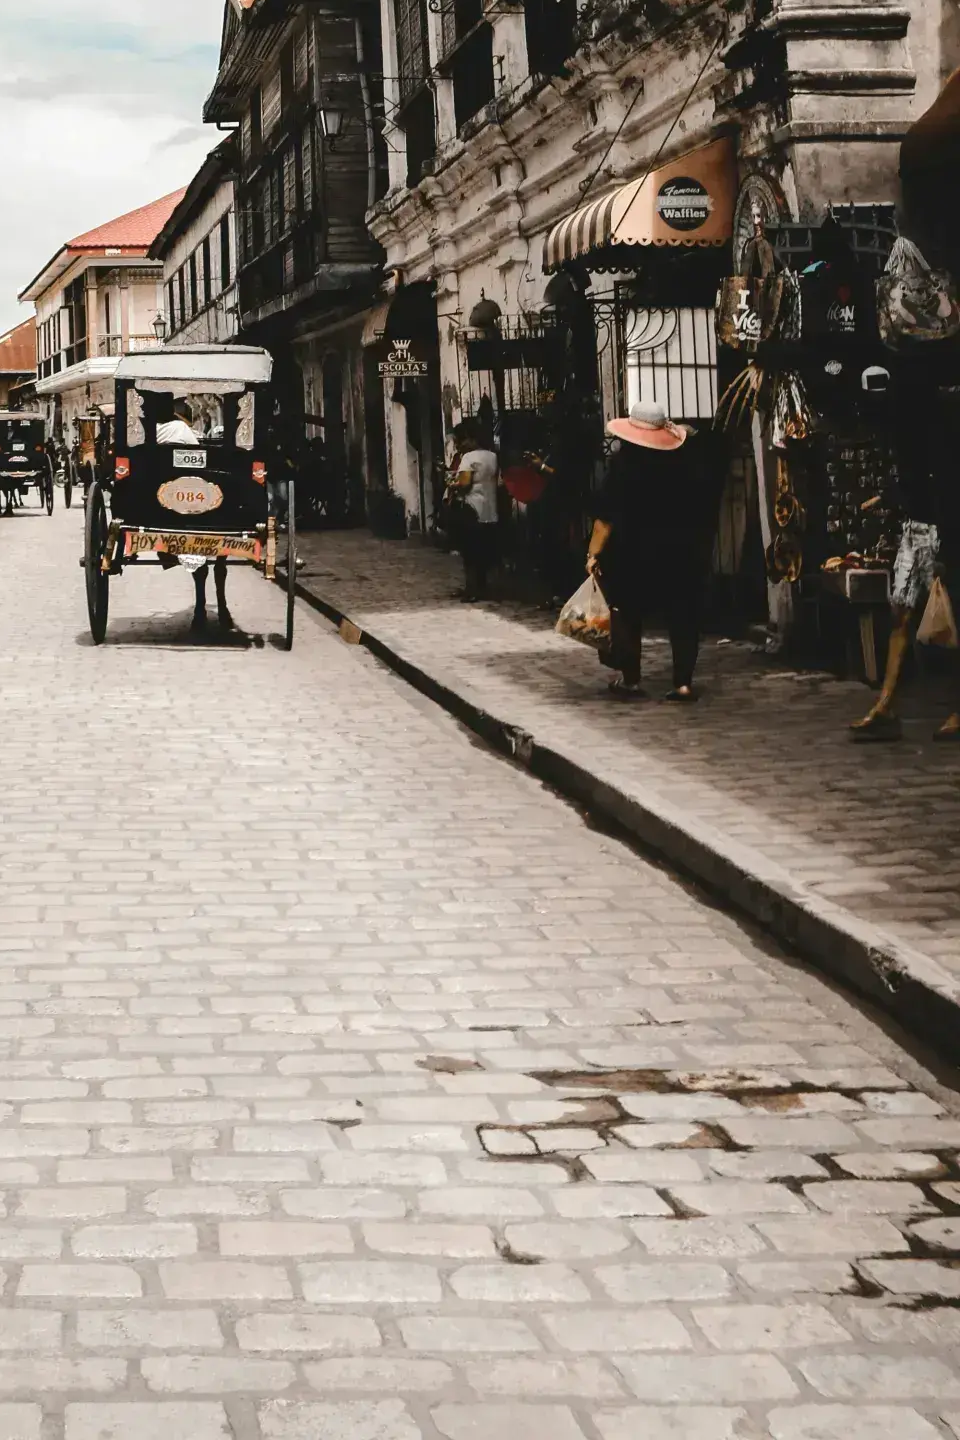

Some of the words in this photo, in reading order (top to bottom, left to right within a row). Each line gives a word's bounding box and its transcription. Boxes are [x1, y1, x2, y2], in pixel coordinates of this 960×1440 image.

[664, 185, 700, 197] Famous
[663, 208, 706, 218] Waffles
[378, 362, 428, 371] ESCOLTA'S
[183, 455, 204, 464] 084
[176, 491, 205, 503] 084
[131, 534, 157, 551] HOY
[160, 534, 187, 545] WAG
